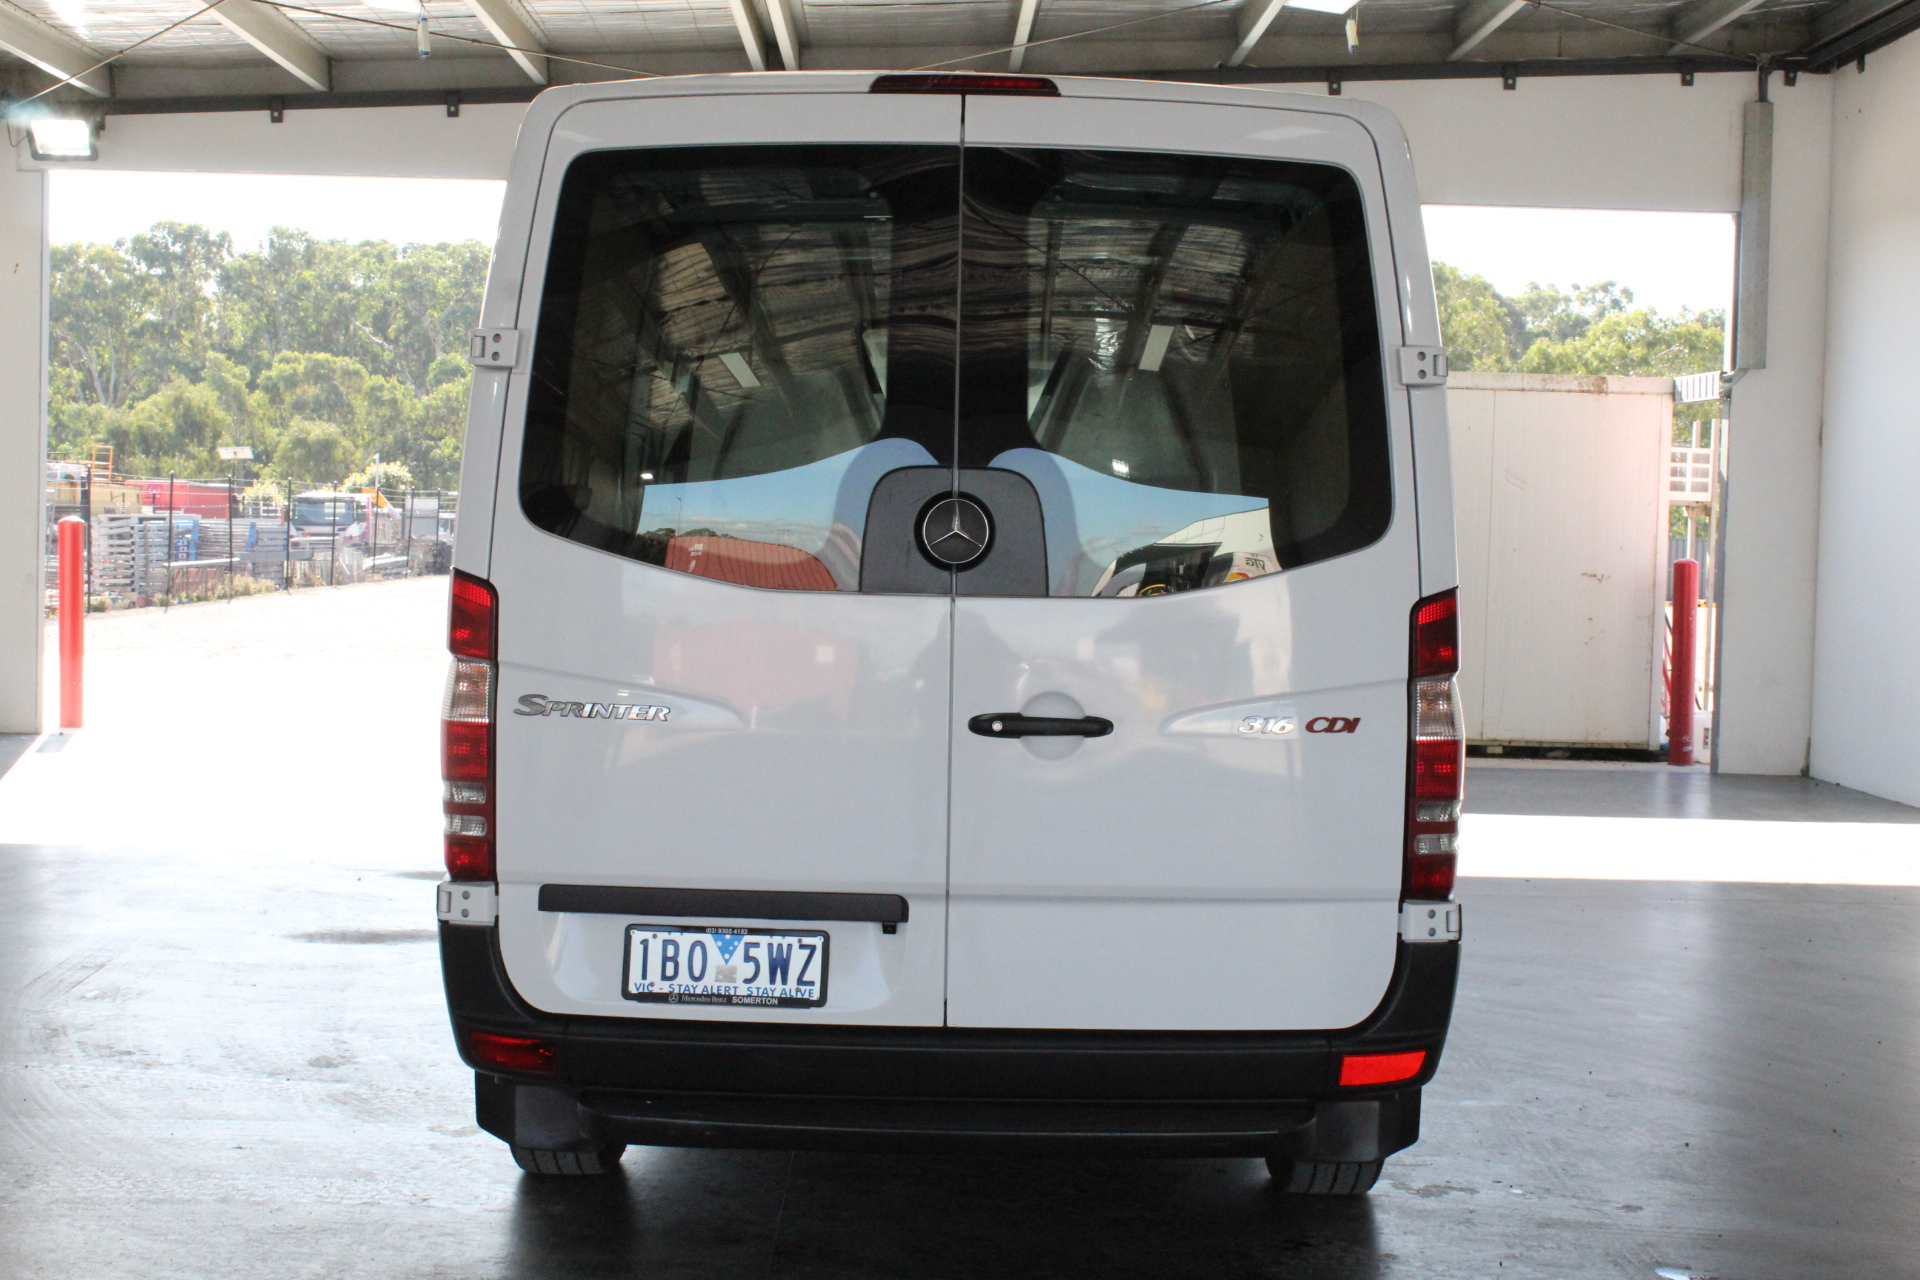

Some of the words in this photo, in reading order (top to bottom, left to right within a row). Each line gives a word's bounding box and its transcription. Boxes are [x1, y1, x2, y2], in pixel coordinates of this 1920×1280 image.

[1238, 715, 1294, 735] 316
[1305, 716, 1361, 734] CDI
[742, 941, 818, 987] 5WZ
[634, 982, 655, 993] VIC
[668, 983, 699, 995] STAY
[701, 985, 739, 996] ALERT
[746, 986, 777, 998] STAY
[779, 987, 815, 999] ALIVE
[732, 996, 779, 1005] SOMERTON
